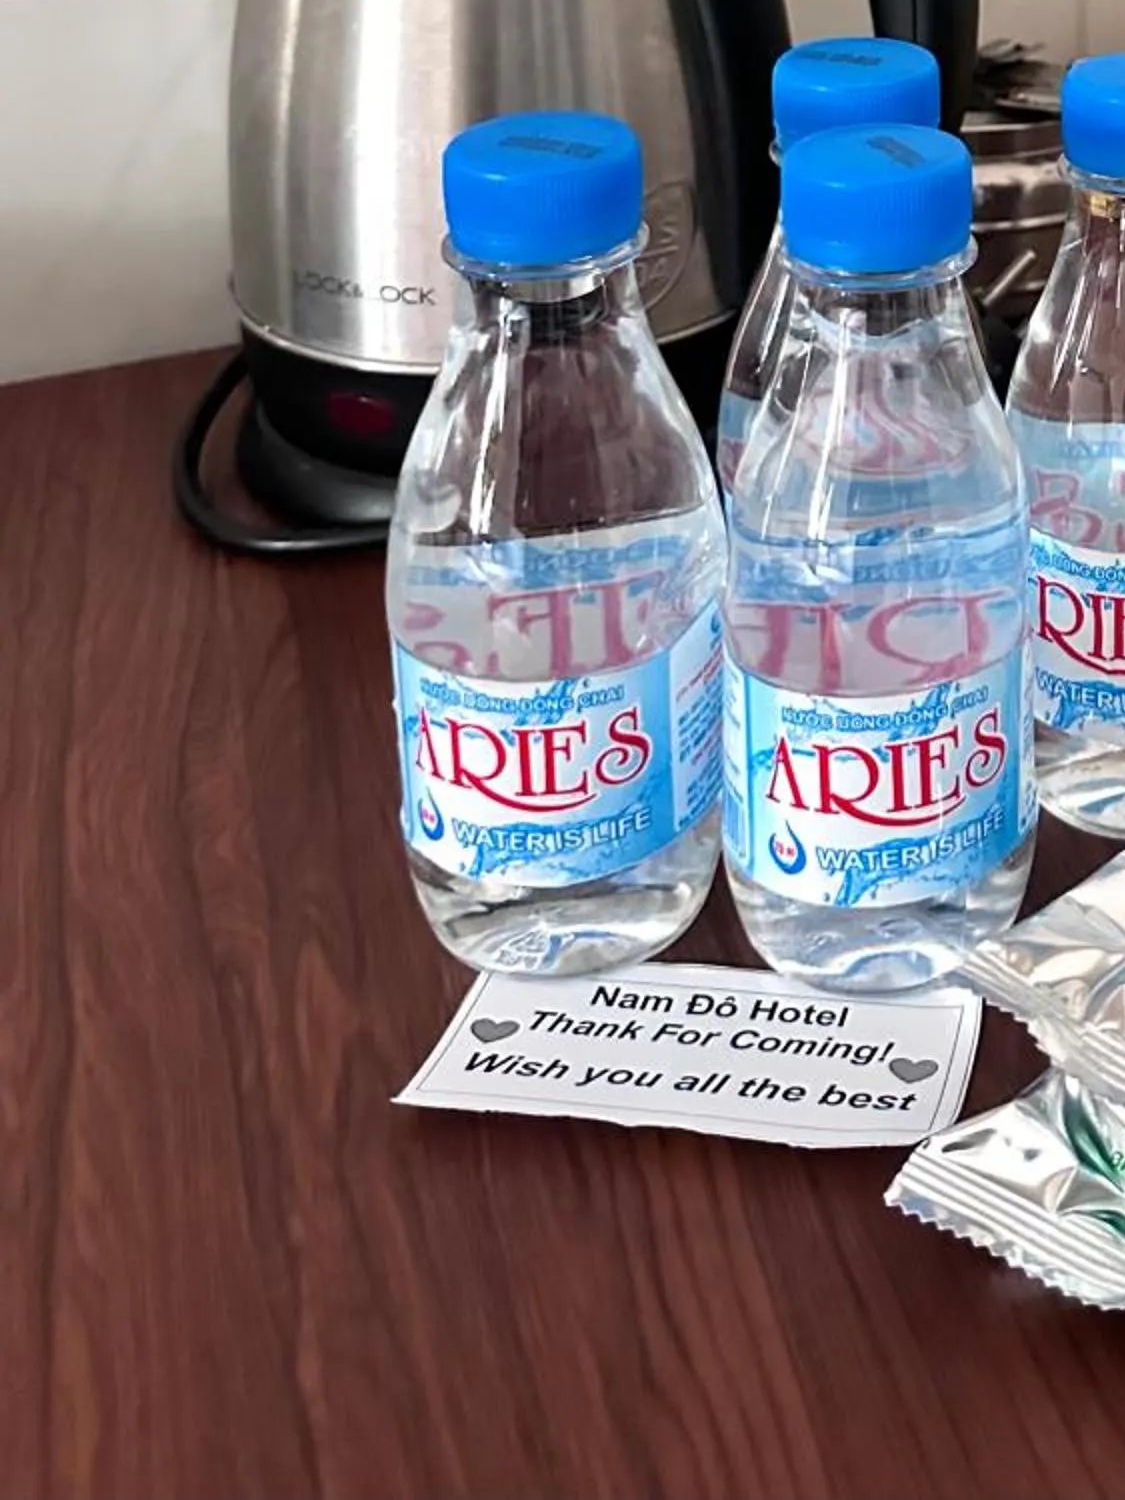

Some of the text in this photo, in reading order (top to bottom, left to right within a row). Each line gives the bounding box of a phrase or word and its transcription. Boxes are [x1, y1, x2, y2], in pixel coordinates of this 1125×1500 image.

[414, 705, 652, 814] ARIES
[764, 708, 1008, 827] ARIES
[451, 808, 652, 852] WATER IS LIFE
[815, 842, 922, 873] WATER
[926, 833, 956, 861] IS
[962, 808, 1006, 850] LIFE
[529, 1009, 894, 1064] Thank For Coming!
[590, 985, 850, 1027] Nam Đô Hotel
[464, 1050, 919, 1112] Wish you all the best
